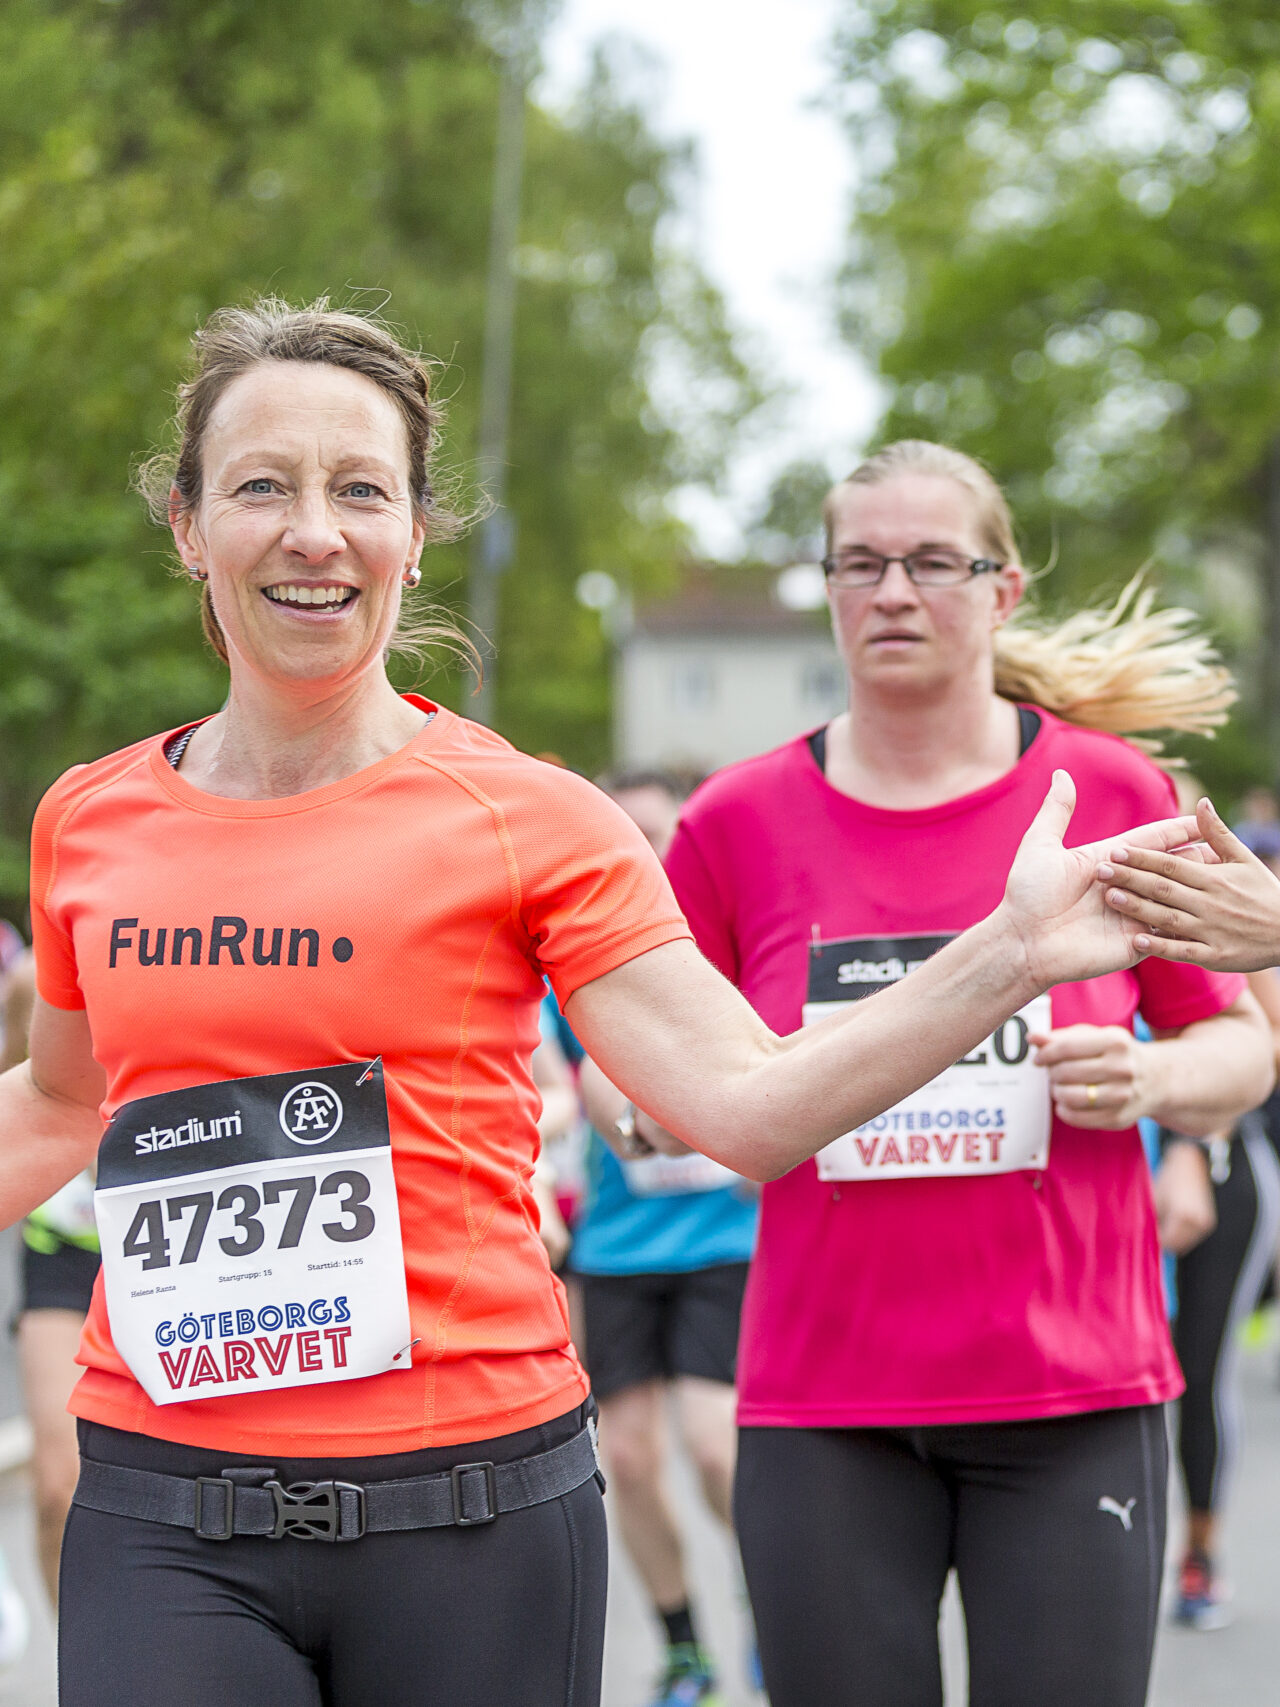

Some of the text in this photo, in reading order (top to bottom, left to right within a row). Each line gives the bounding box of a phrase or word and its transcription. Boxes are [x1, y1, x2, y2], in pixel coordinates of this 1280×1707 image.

[135, 1112, 242, 1155] stadium
[854, 1131, 1005, 1167] VARVET
[123, 1170, 376, 1271] 47373
[218, 1268, 273, 1283] Startgrupp: 15
[307, 1257, 364, 1271] Starttid: 14:55
[155, 1296, 352, 1347] GÖTEBORGS
[158, 1326, 352, 1390] VARVET
